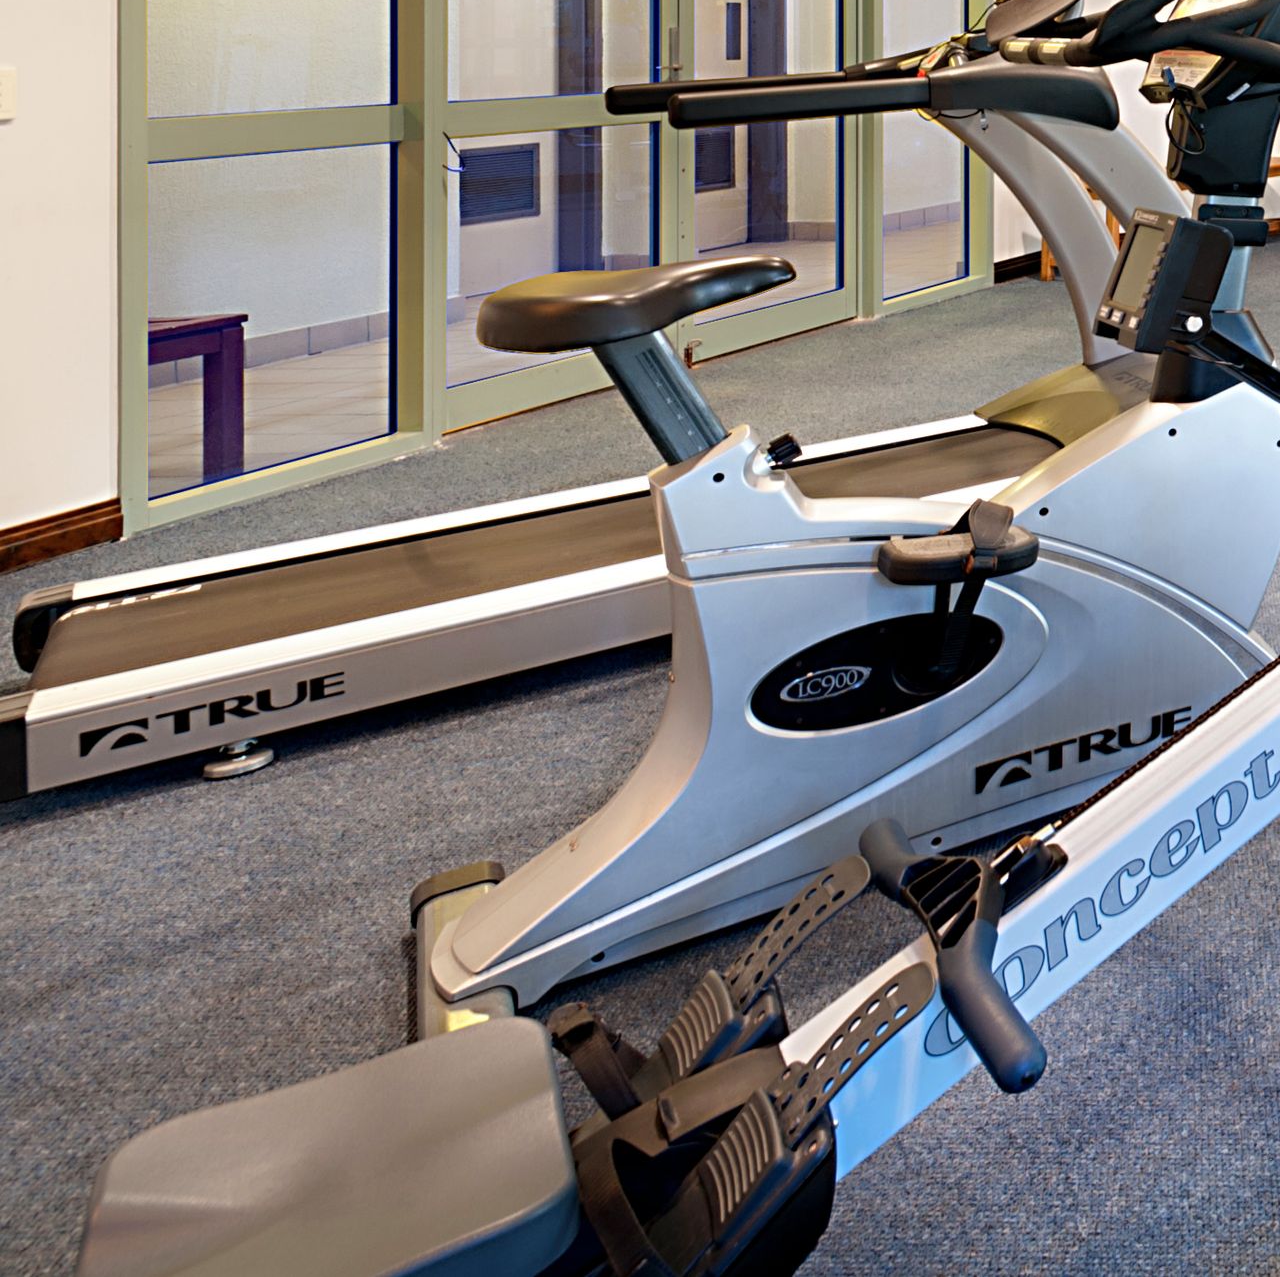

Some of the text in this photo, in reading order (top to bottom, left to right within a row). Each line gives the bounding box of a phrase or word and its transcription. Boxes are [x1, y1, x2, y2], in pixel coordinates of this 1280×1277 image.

[155, 671, 345, 735] TRUE
[797, 669, 859, 699] LC900
[1034, 705, 1192, 772] TRUE
